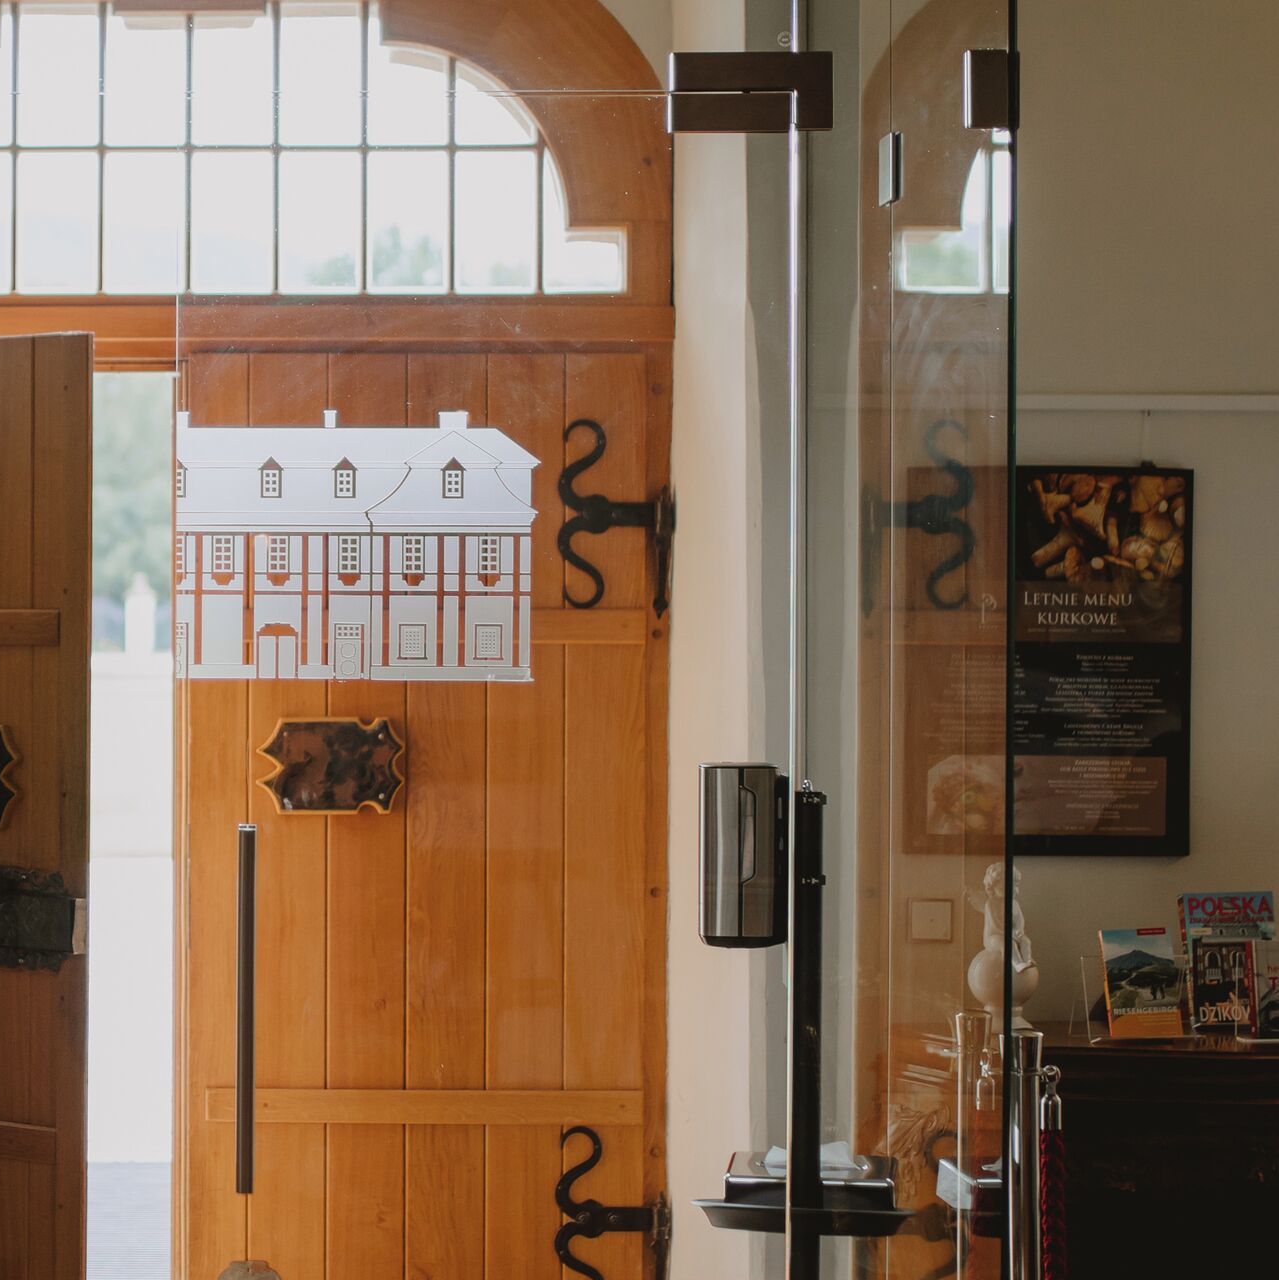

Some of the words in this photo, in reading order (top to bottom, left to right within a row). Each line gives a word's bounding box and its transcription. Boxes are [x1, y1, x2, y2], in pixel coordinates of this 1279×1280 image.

[1024, 591, 1078, 606] LETNIE
[1084, 592, 1133, 607] MENU
[1037, 611, 1118, 626] KURKOWE
[1188, 895, 1273, 916] POLSKA
[1113, 1005, 1177, 1017] RIESENGEBIRGE
